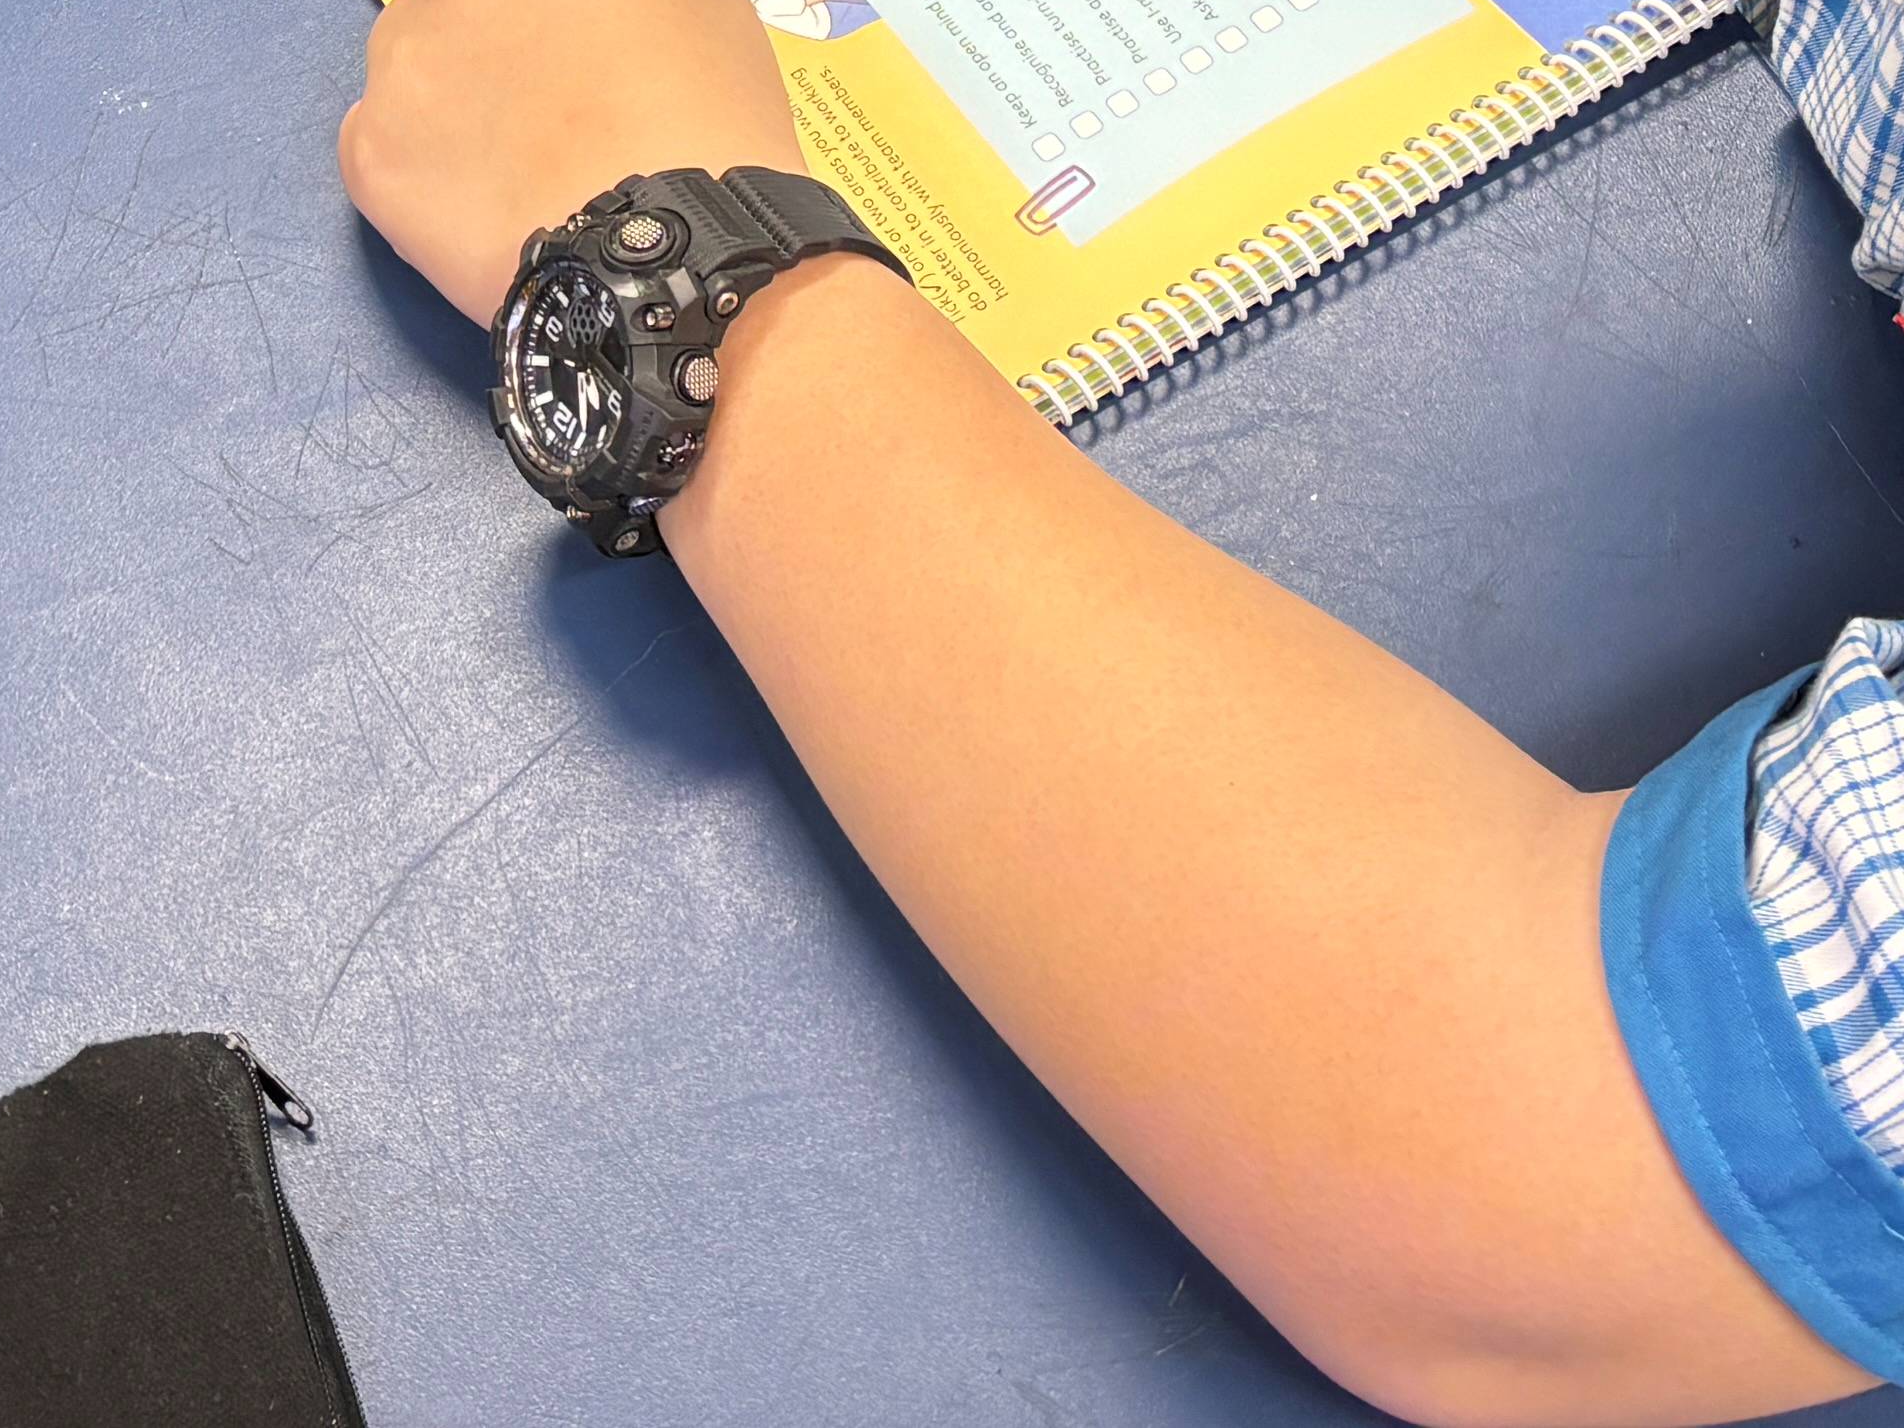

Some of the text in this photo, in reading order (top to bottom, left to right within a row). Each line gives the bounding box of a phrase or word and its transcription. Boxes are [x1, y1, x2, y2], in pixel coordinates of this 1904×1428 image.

[924, 0, 962, 37] mind
[986, 11, 1018, 39] and
[1098, 9, 1148, 64] Practise
[1156, 15, 1182, 44] Use
[958, 35, 991, 72] open
[1061, 30, 1112, 86] Practise
[987, 71, 1008, 92] an
[1013, 38, 1074, 108] Recognise
[1004, 92, 1038, 129] Keep
[789, 66, 987, 311] do better in to contribute to working
[818, 64, 1009, 302] harmoniously with team members.
[545, 315, 564, 343] 3
[553, 401, 578, 441] 12
